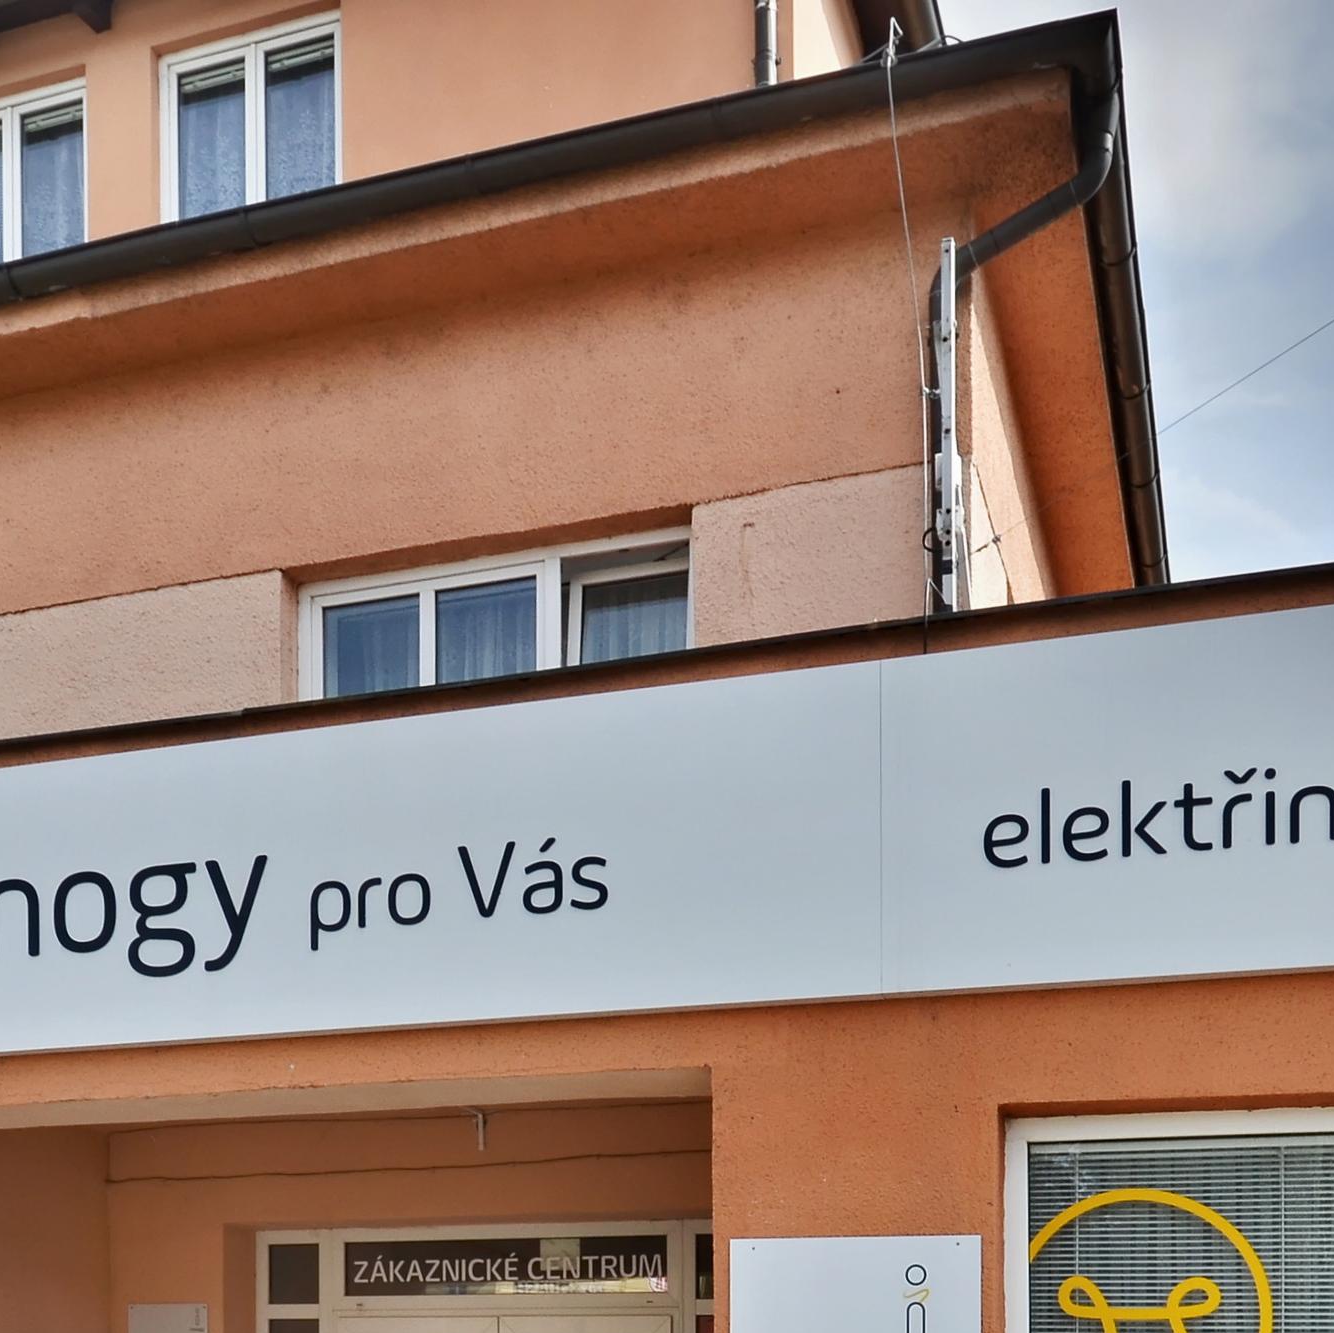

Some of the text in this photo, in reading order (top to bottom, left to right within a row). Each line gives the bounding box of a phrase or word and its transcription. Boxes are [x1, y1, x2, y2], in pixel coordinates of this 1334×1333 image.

[310, 873, 431, 952] pro
[457, 837, 609, 919] Vás
[353, 1253, 663, 1284] ZÁKAZNICKÉ CENTRUM
